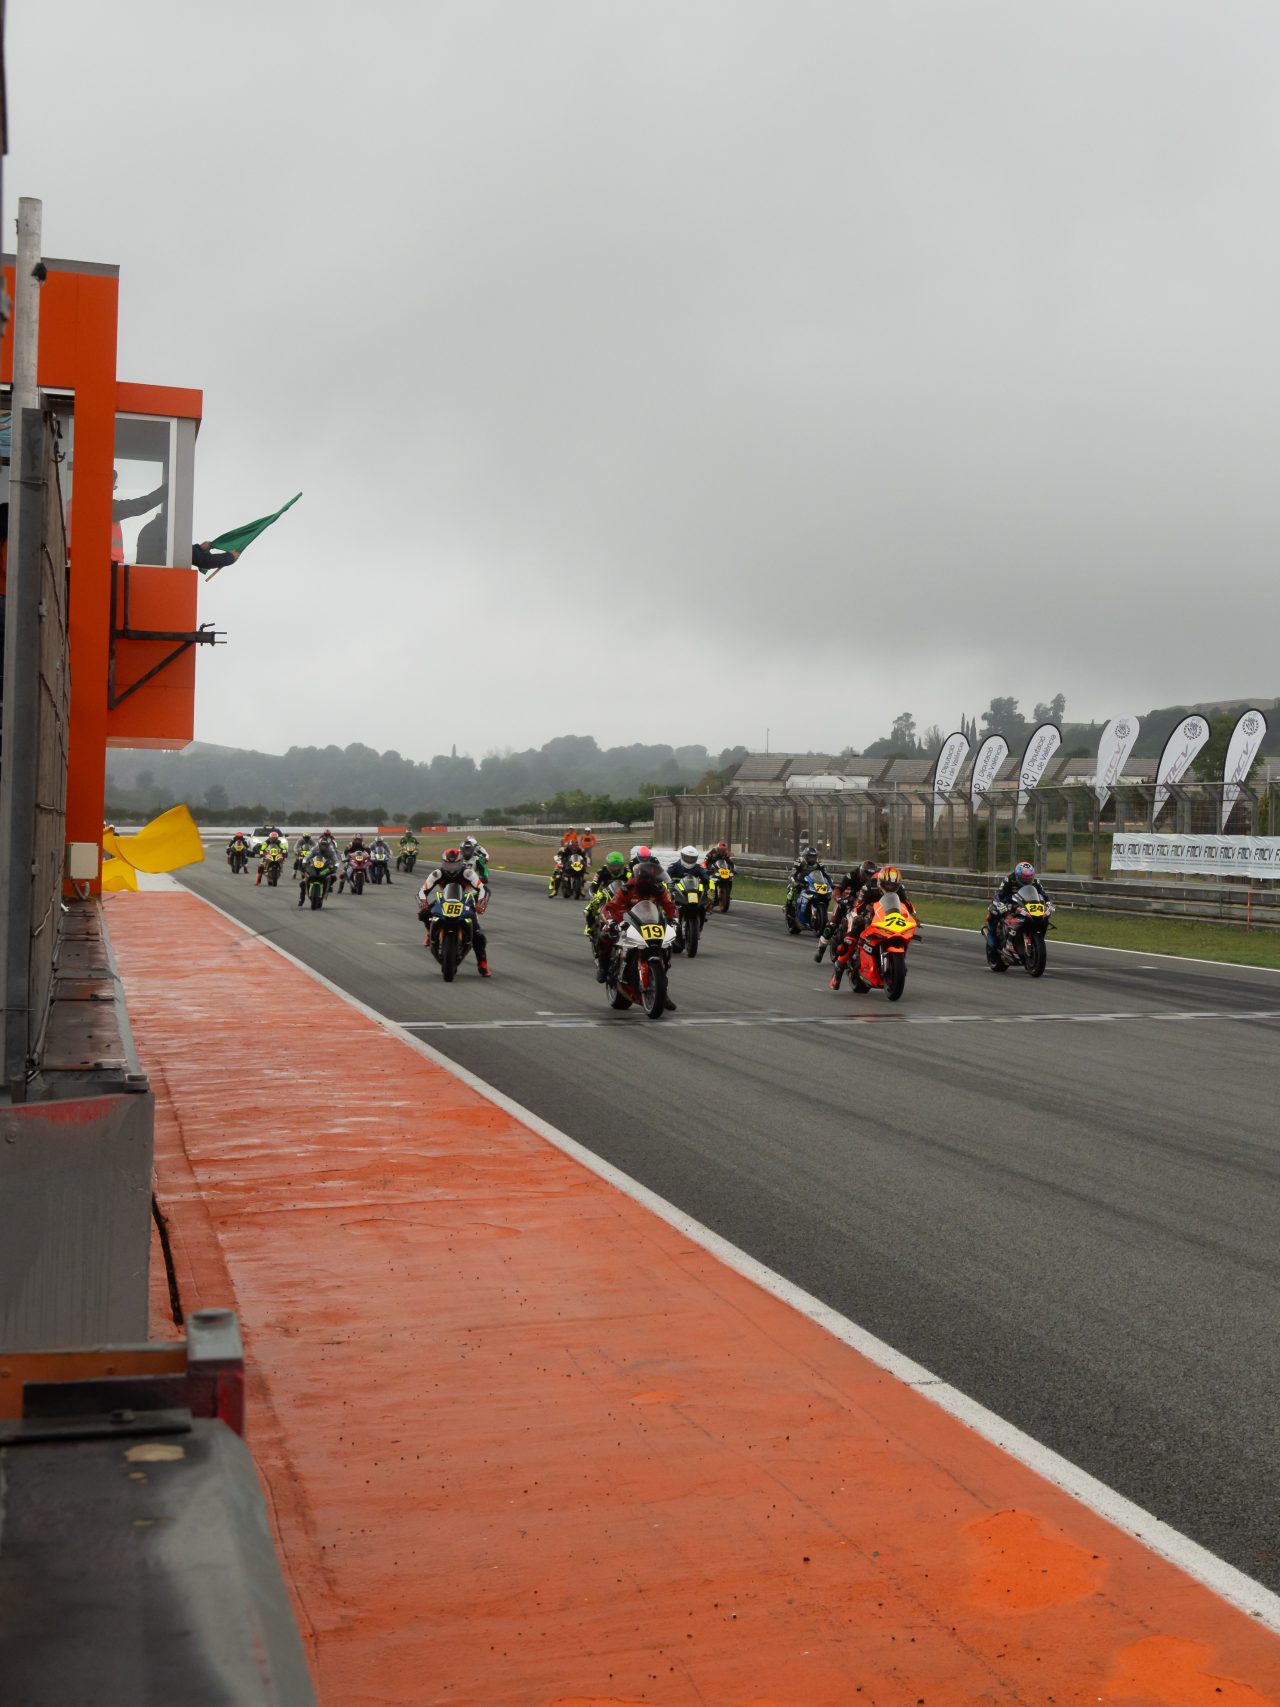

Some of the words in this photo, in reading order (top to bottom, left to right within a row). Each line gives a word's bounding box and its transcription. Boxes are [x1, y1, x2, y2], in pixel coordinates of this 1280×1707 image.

[446, 904, 462, 915] 86
[1029, 904, 1044, 913] 24
[642, 925, 663, 938] 19
